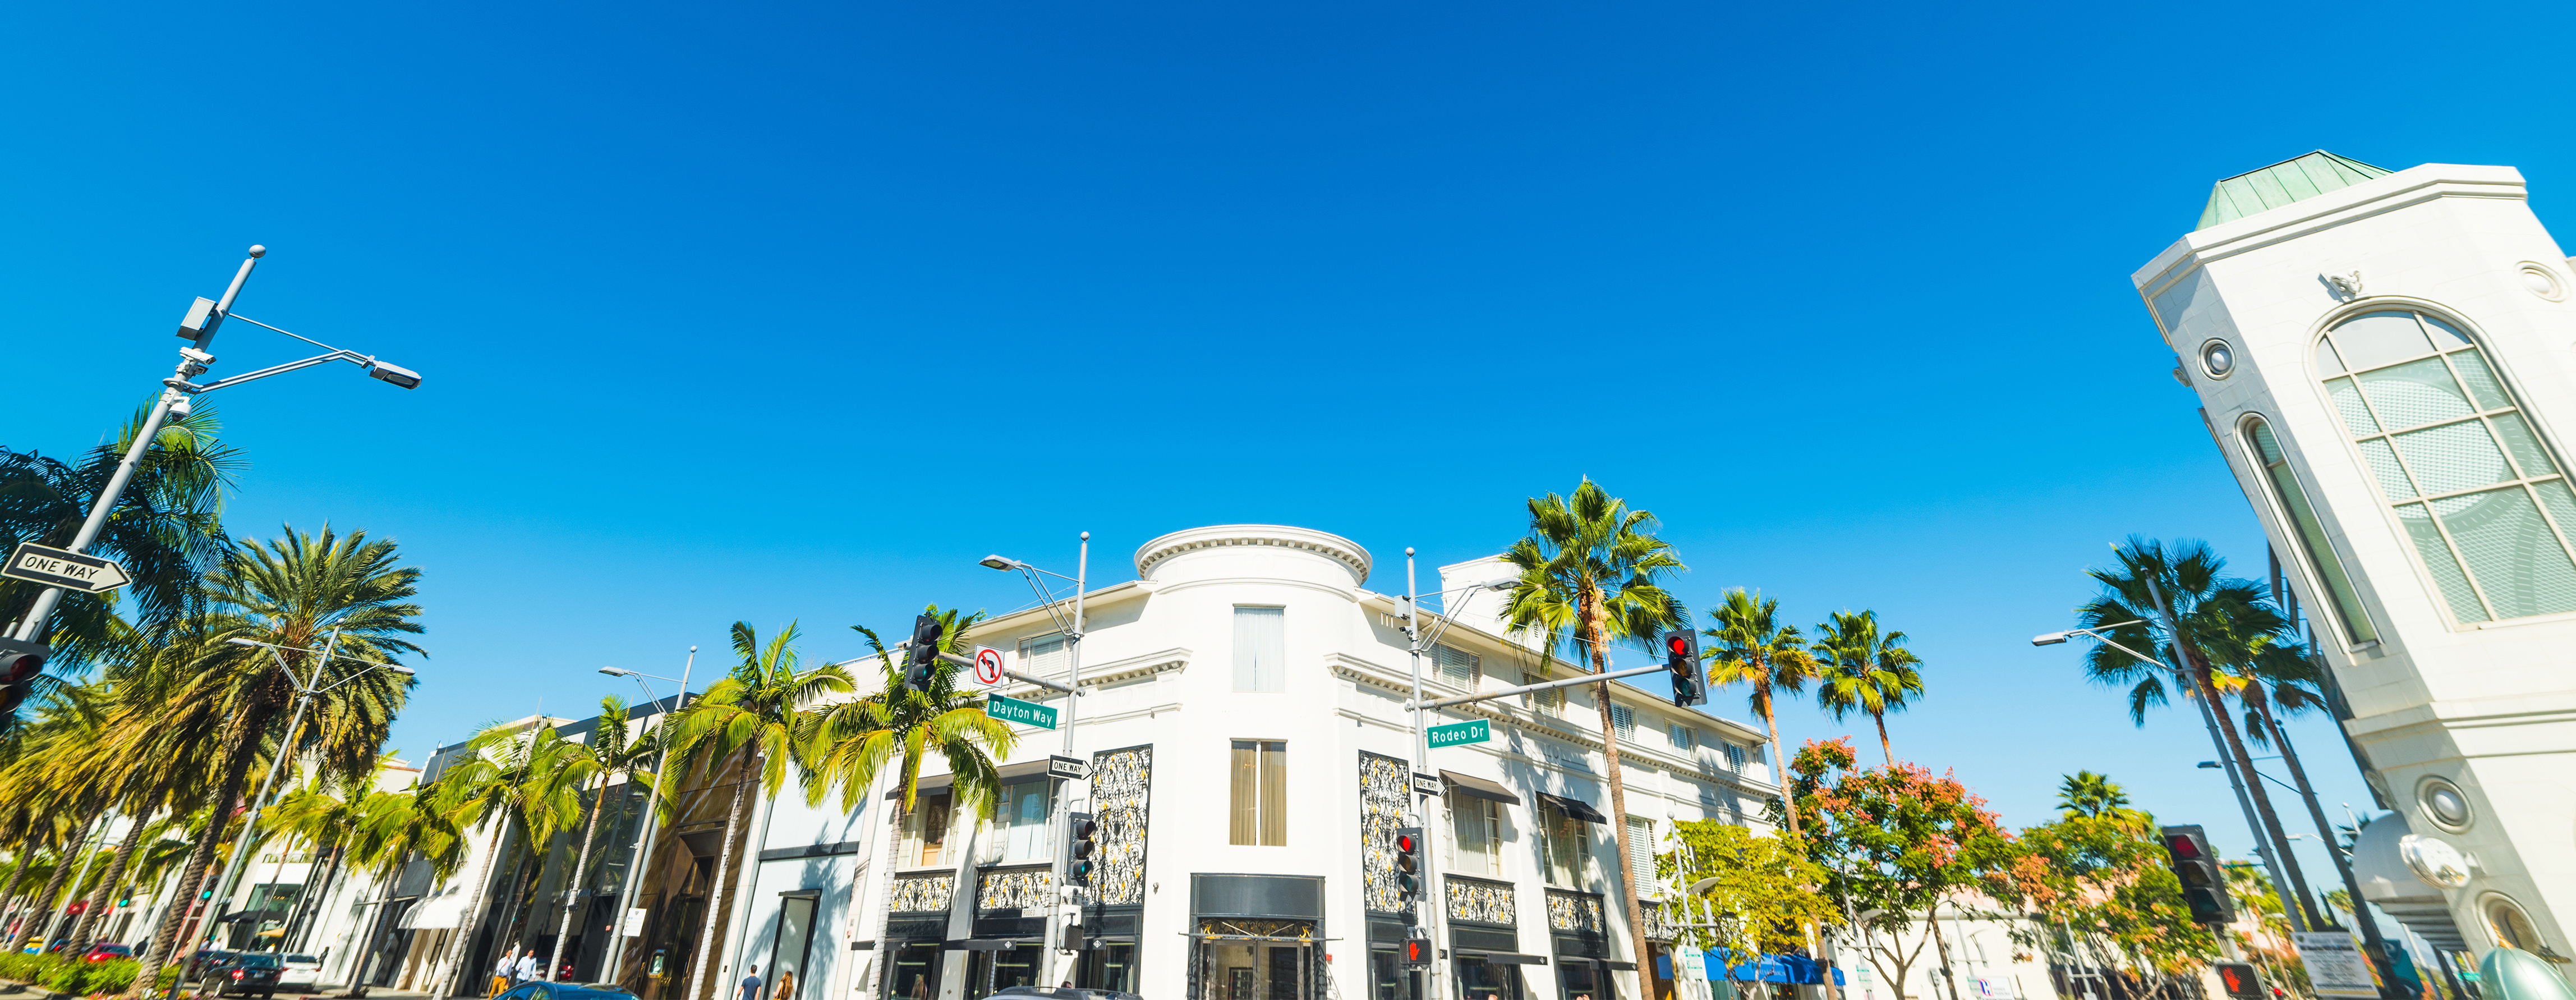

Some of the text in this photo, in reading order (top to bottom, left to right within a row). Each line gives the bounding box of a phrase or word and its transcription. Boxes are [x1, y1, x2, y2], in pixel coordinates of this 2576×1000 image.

[25, 556, 99, 580] ONE WAY
[993, 700, 1052, 727] Dayton Way
[1432, 726, 1484, 744] Rodeo Dr
[1054, 762, 1082, 773] ONE WAY
[1416, 779, 1437, 790] ONE WAY
